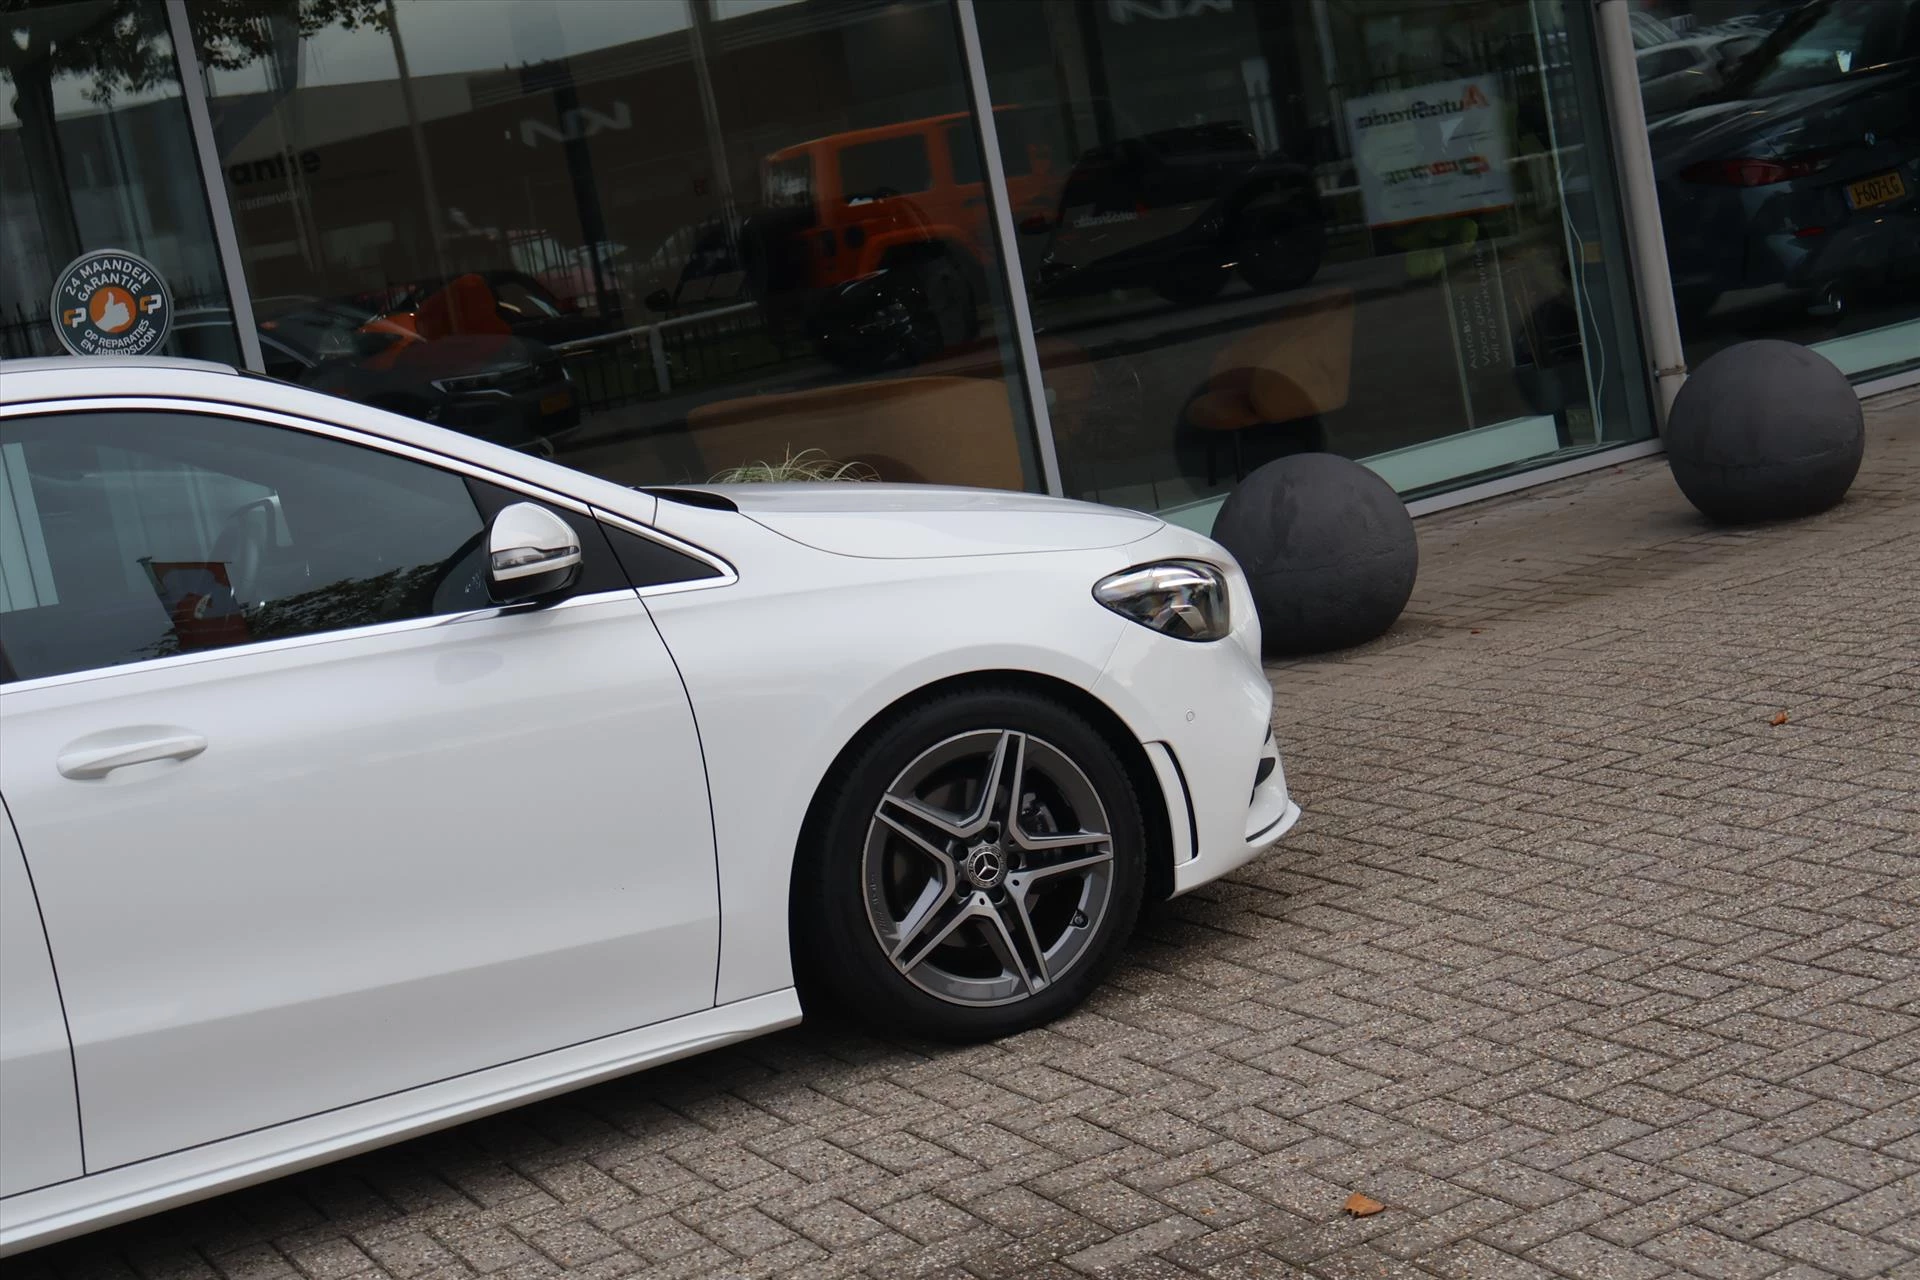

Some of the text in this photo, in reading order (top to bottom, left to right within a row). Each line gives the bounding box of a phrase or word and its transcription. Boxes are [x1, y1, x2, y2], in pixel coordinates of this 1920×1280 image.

[65, 259, 151, 297] 24 MAANDEN
[77, 272, 142, 302] GARANTIE
[80, 328, 157, 356] EN ARBEIDSLOON
[84, 319, 150, 348] OP REPARATIES
